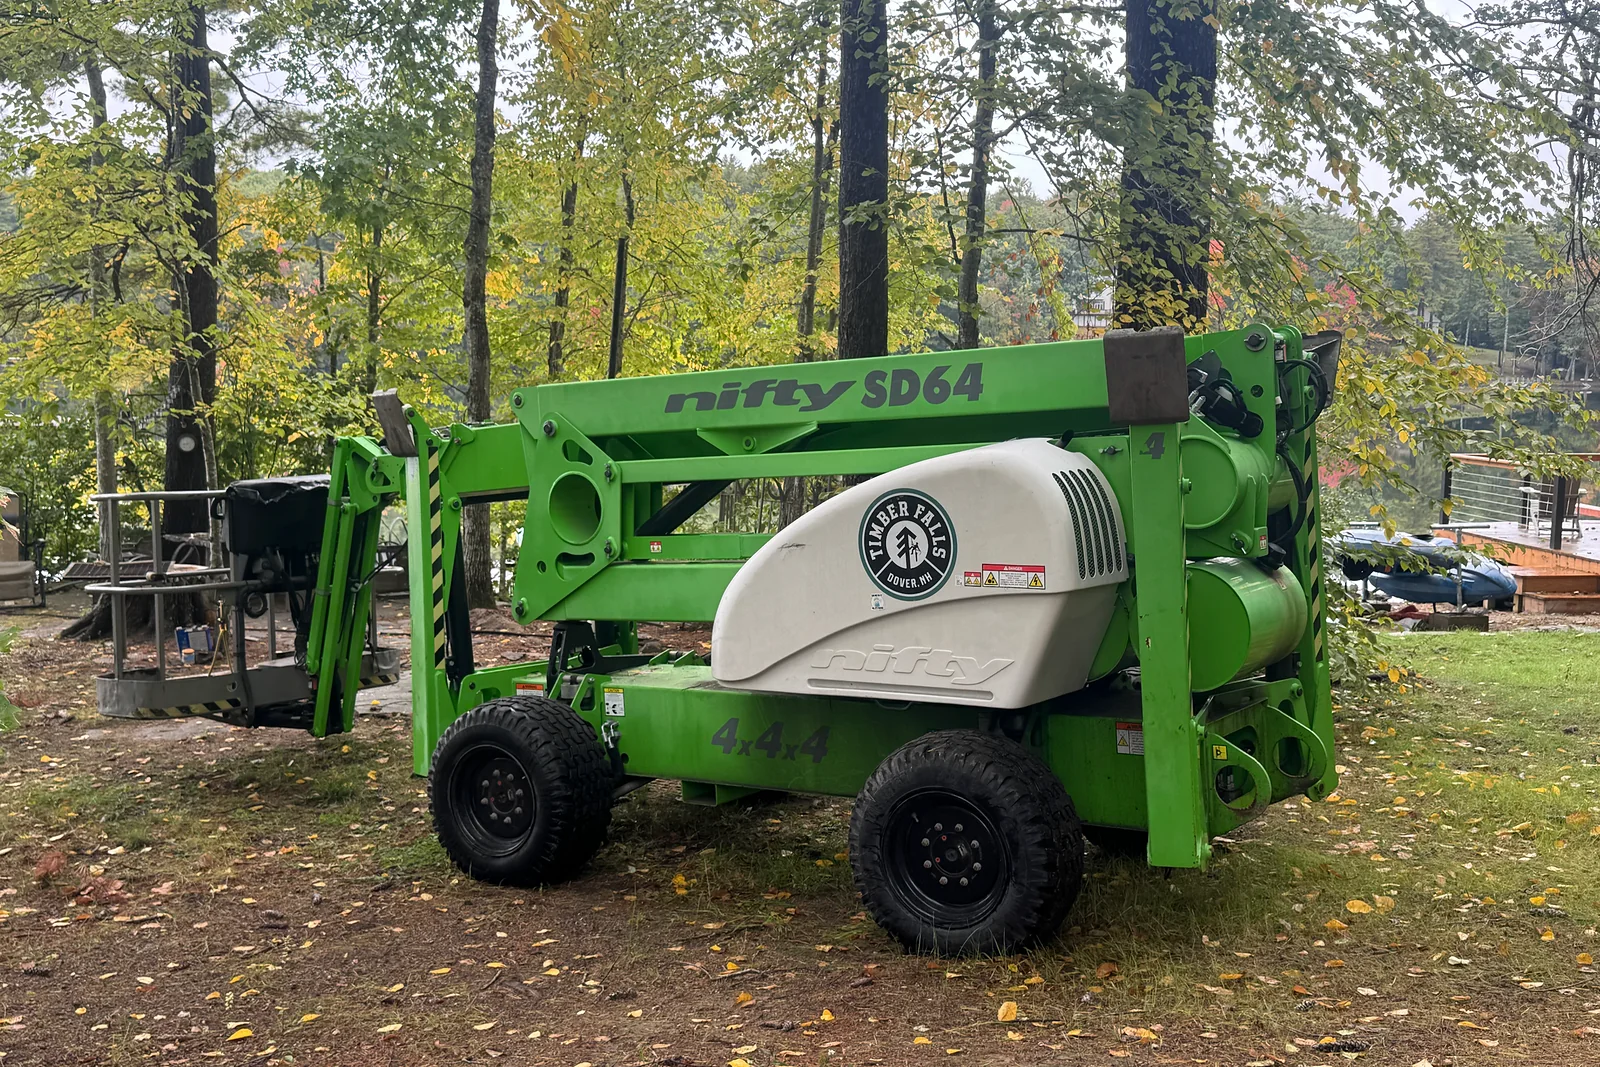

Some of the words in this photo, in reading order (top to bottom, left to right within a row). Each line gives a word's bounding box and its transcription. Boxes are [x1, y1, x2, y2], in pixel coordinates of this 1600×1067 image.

[664, 379, 857, 412] nifty
[861, 362, 984, 409] SD64
[1139, 431, 1166, 460] 4
[868, 500, 910, 561] TIMBER
[913, 503, 947, 559] FALLS
[811, 643, 1015, 686] nifty
[710, 717, 831, 764] 4x4x4
